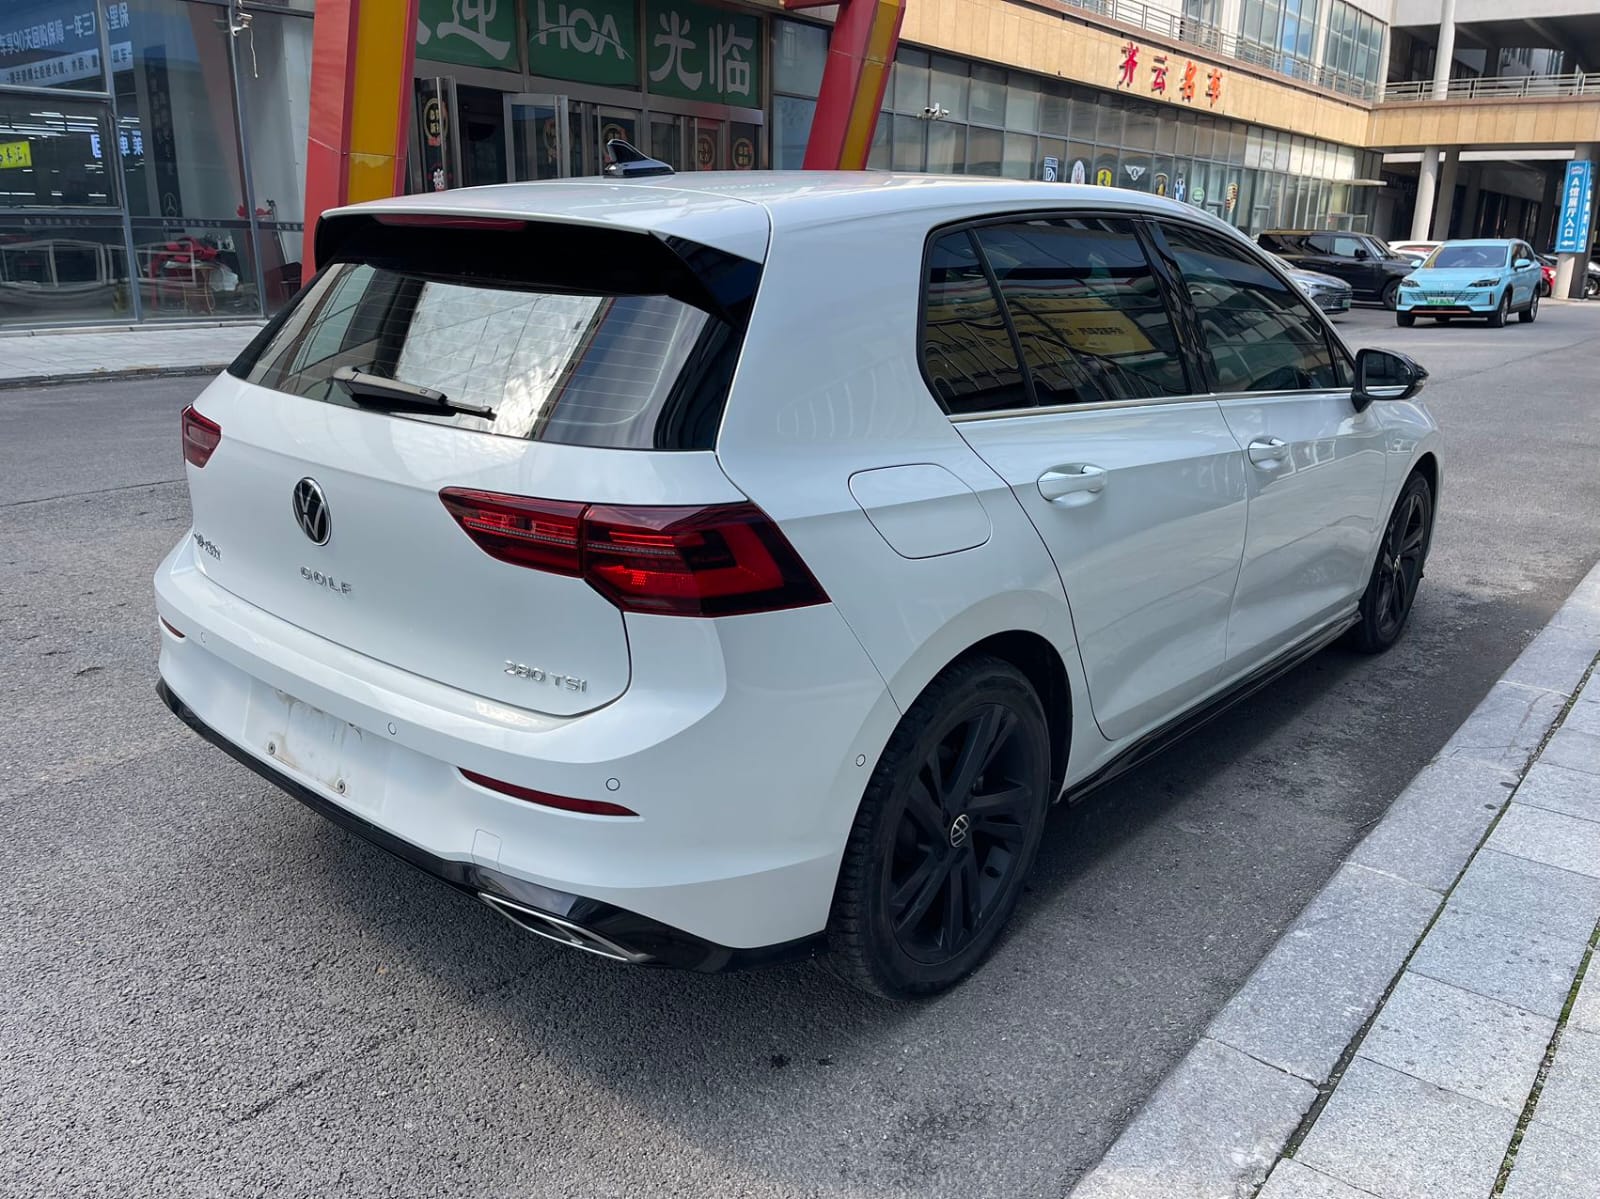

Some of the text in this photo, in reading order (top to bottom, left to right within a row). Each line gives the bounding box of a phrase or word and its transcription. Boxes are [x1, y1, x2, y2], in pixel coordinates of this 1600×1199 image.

[417, 0, 511, 60] 迎
[536, 0, 626, 60] HOA
[648, 10, 753, 97] 光临
[1119, 41, 1222, 108] 齐云名车
[301, 566, 352, 594] GOLF
[504, 660, 587, 693] 280 TSI
